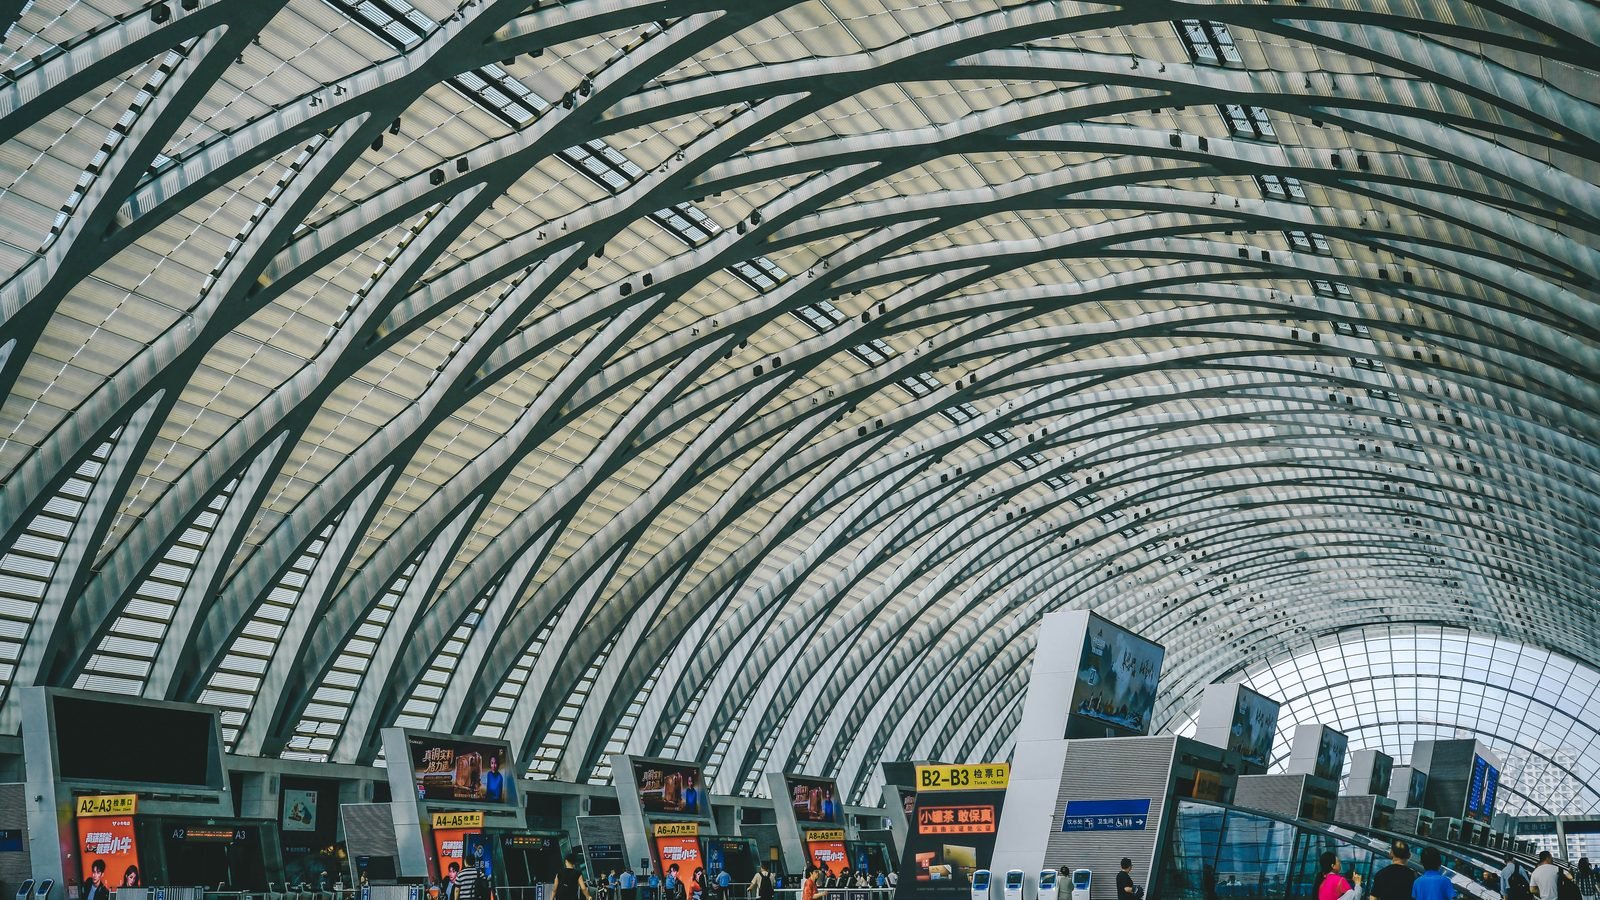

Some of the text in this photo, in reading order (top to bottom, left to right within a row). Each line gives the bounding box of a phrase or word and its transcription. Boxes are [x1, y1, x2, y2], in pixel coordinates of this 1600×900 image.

[922, 769, 969, 787] B2-B3
[974, 768, 1004, 778] 检票口
[81, 800, 112, 813] A2-A3
[436, 816, 463, 826] A4-A5
[957, 809, 992, 823] 敢保真
[172, 830, 184, 838] A2
[235, 831, 246, 839] A3
[657, 825, 680, 835] A6-A7
[808, 832, 830, 840] A8-A9
[505, 838, 512, 846] A4
